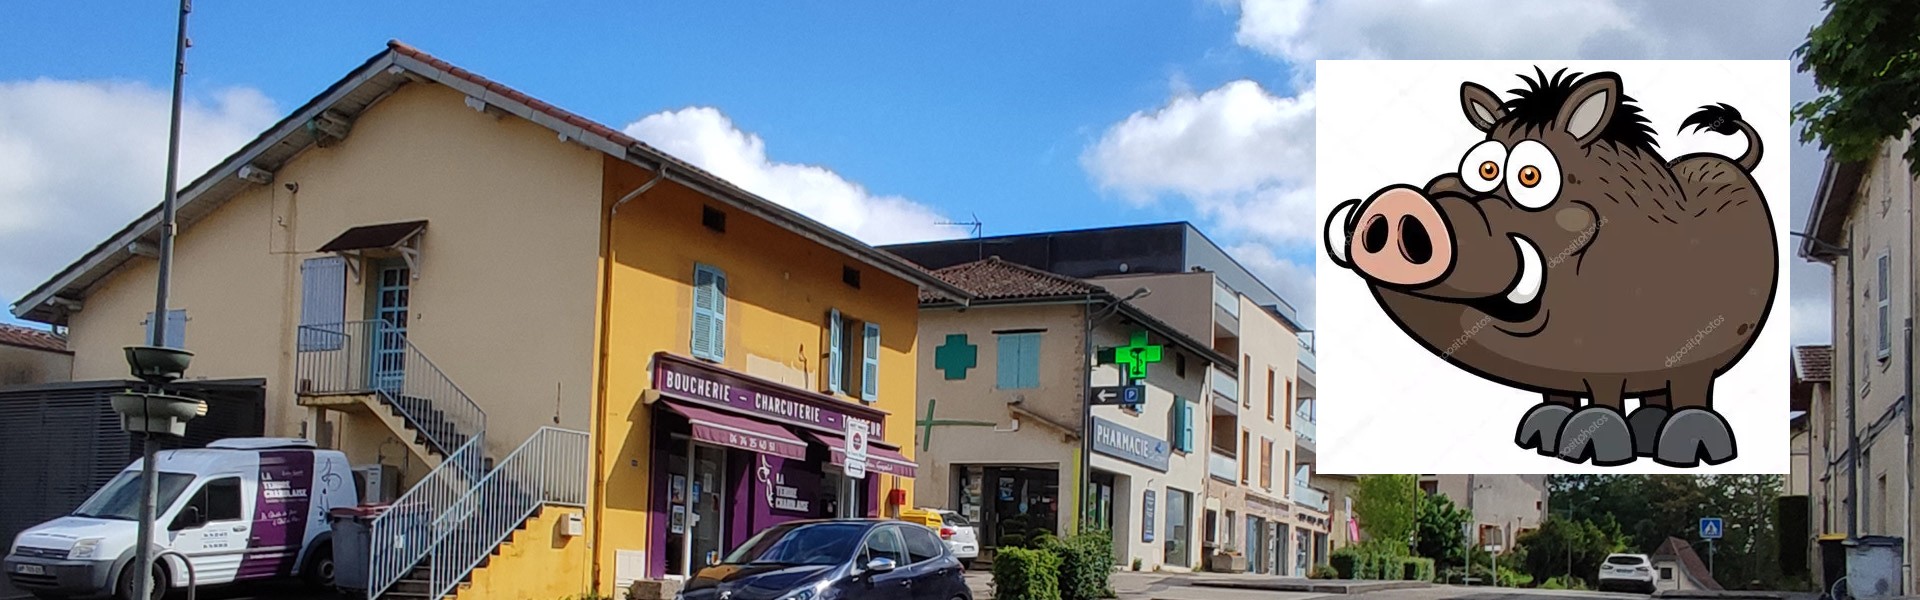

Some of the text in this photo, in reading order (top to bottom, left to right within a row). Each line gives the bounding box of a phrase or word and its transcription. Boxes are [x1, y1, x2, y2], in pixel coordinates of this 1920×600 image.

[666, 370, 731, 402] BOUCHERIE
[755, 392, 820, 423] CHARCUTERIE
[1097, 424, 1148, 458] PHARMACIE
[261, 472, 272, 480] LA
[776, 473, 785, 485] LA
